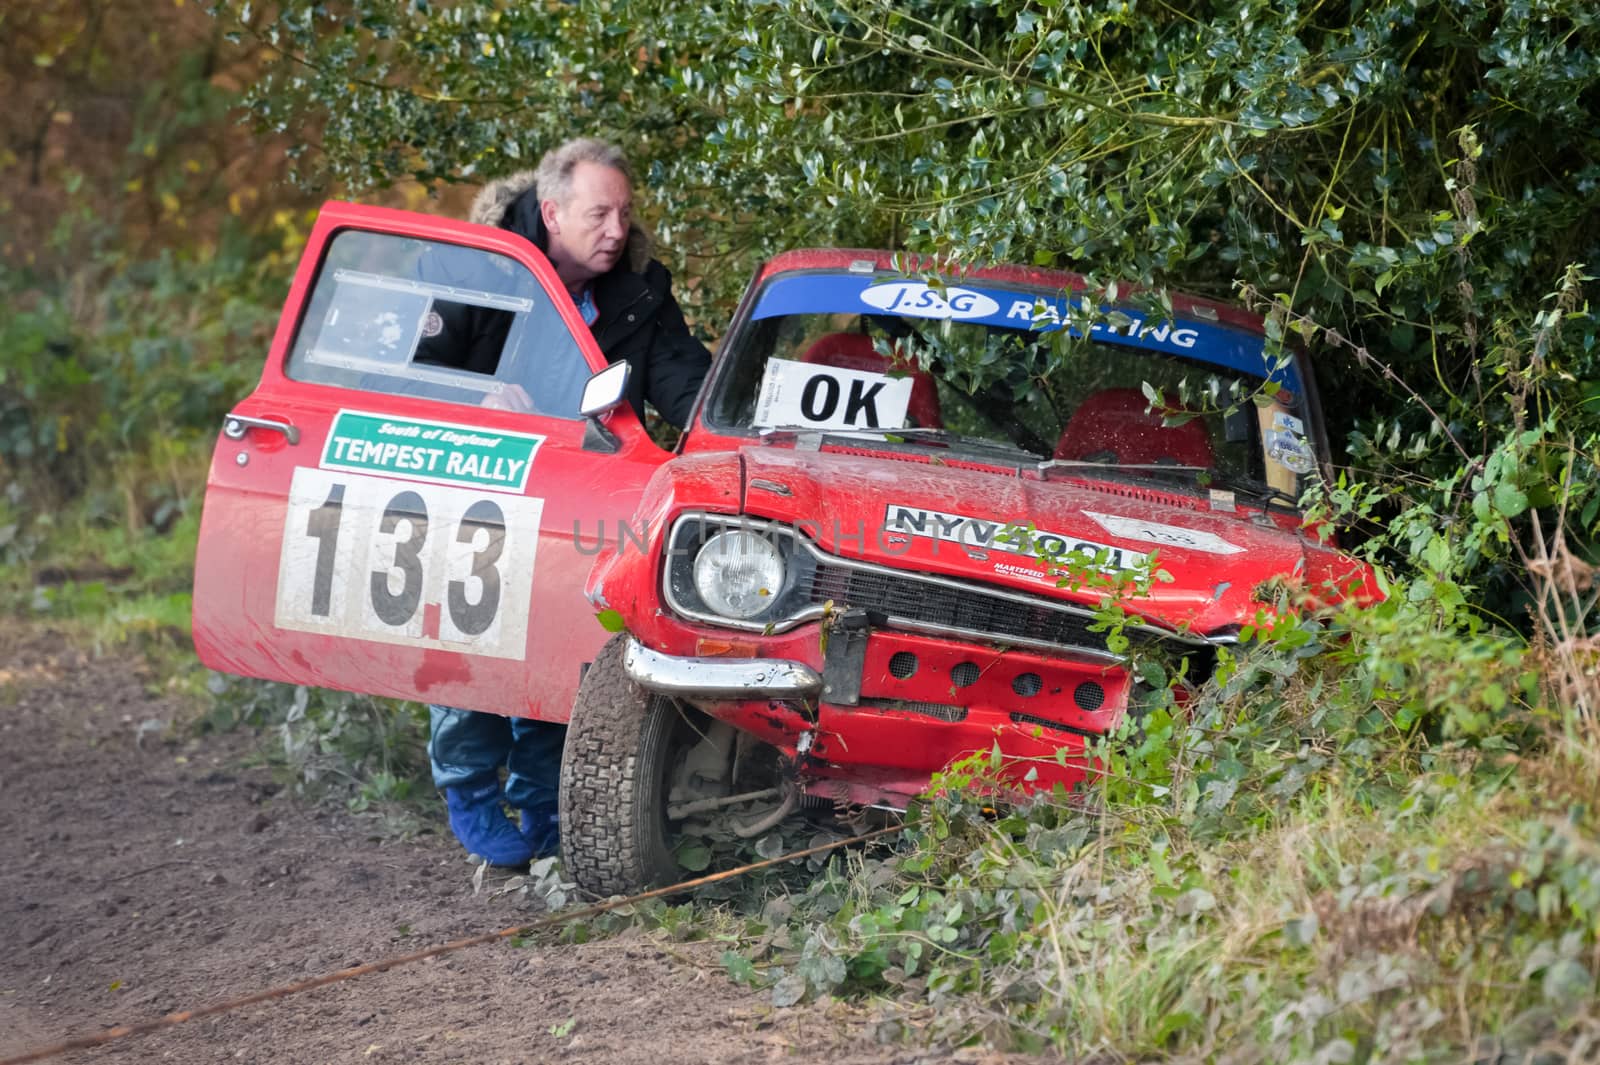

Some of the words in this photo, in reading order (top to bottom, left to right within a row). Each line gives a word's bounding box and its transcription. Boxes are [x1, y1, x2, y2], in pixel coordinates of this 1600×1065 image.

[886, 287, 977, 312] J.S.G
[1006, 300, 1199, 348] RAING
[801, 374, 887, 428] OK
[333, 436, 444, 471] TEMPEST
[446, 451, 525, 482] RALLY
[377, 422, 421, 437] South
[421, 428, 443, 440] of
[439, 431, 503, 448] England
[306, 483, 507, 636] 133
